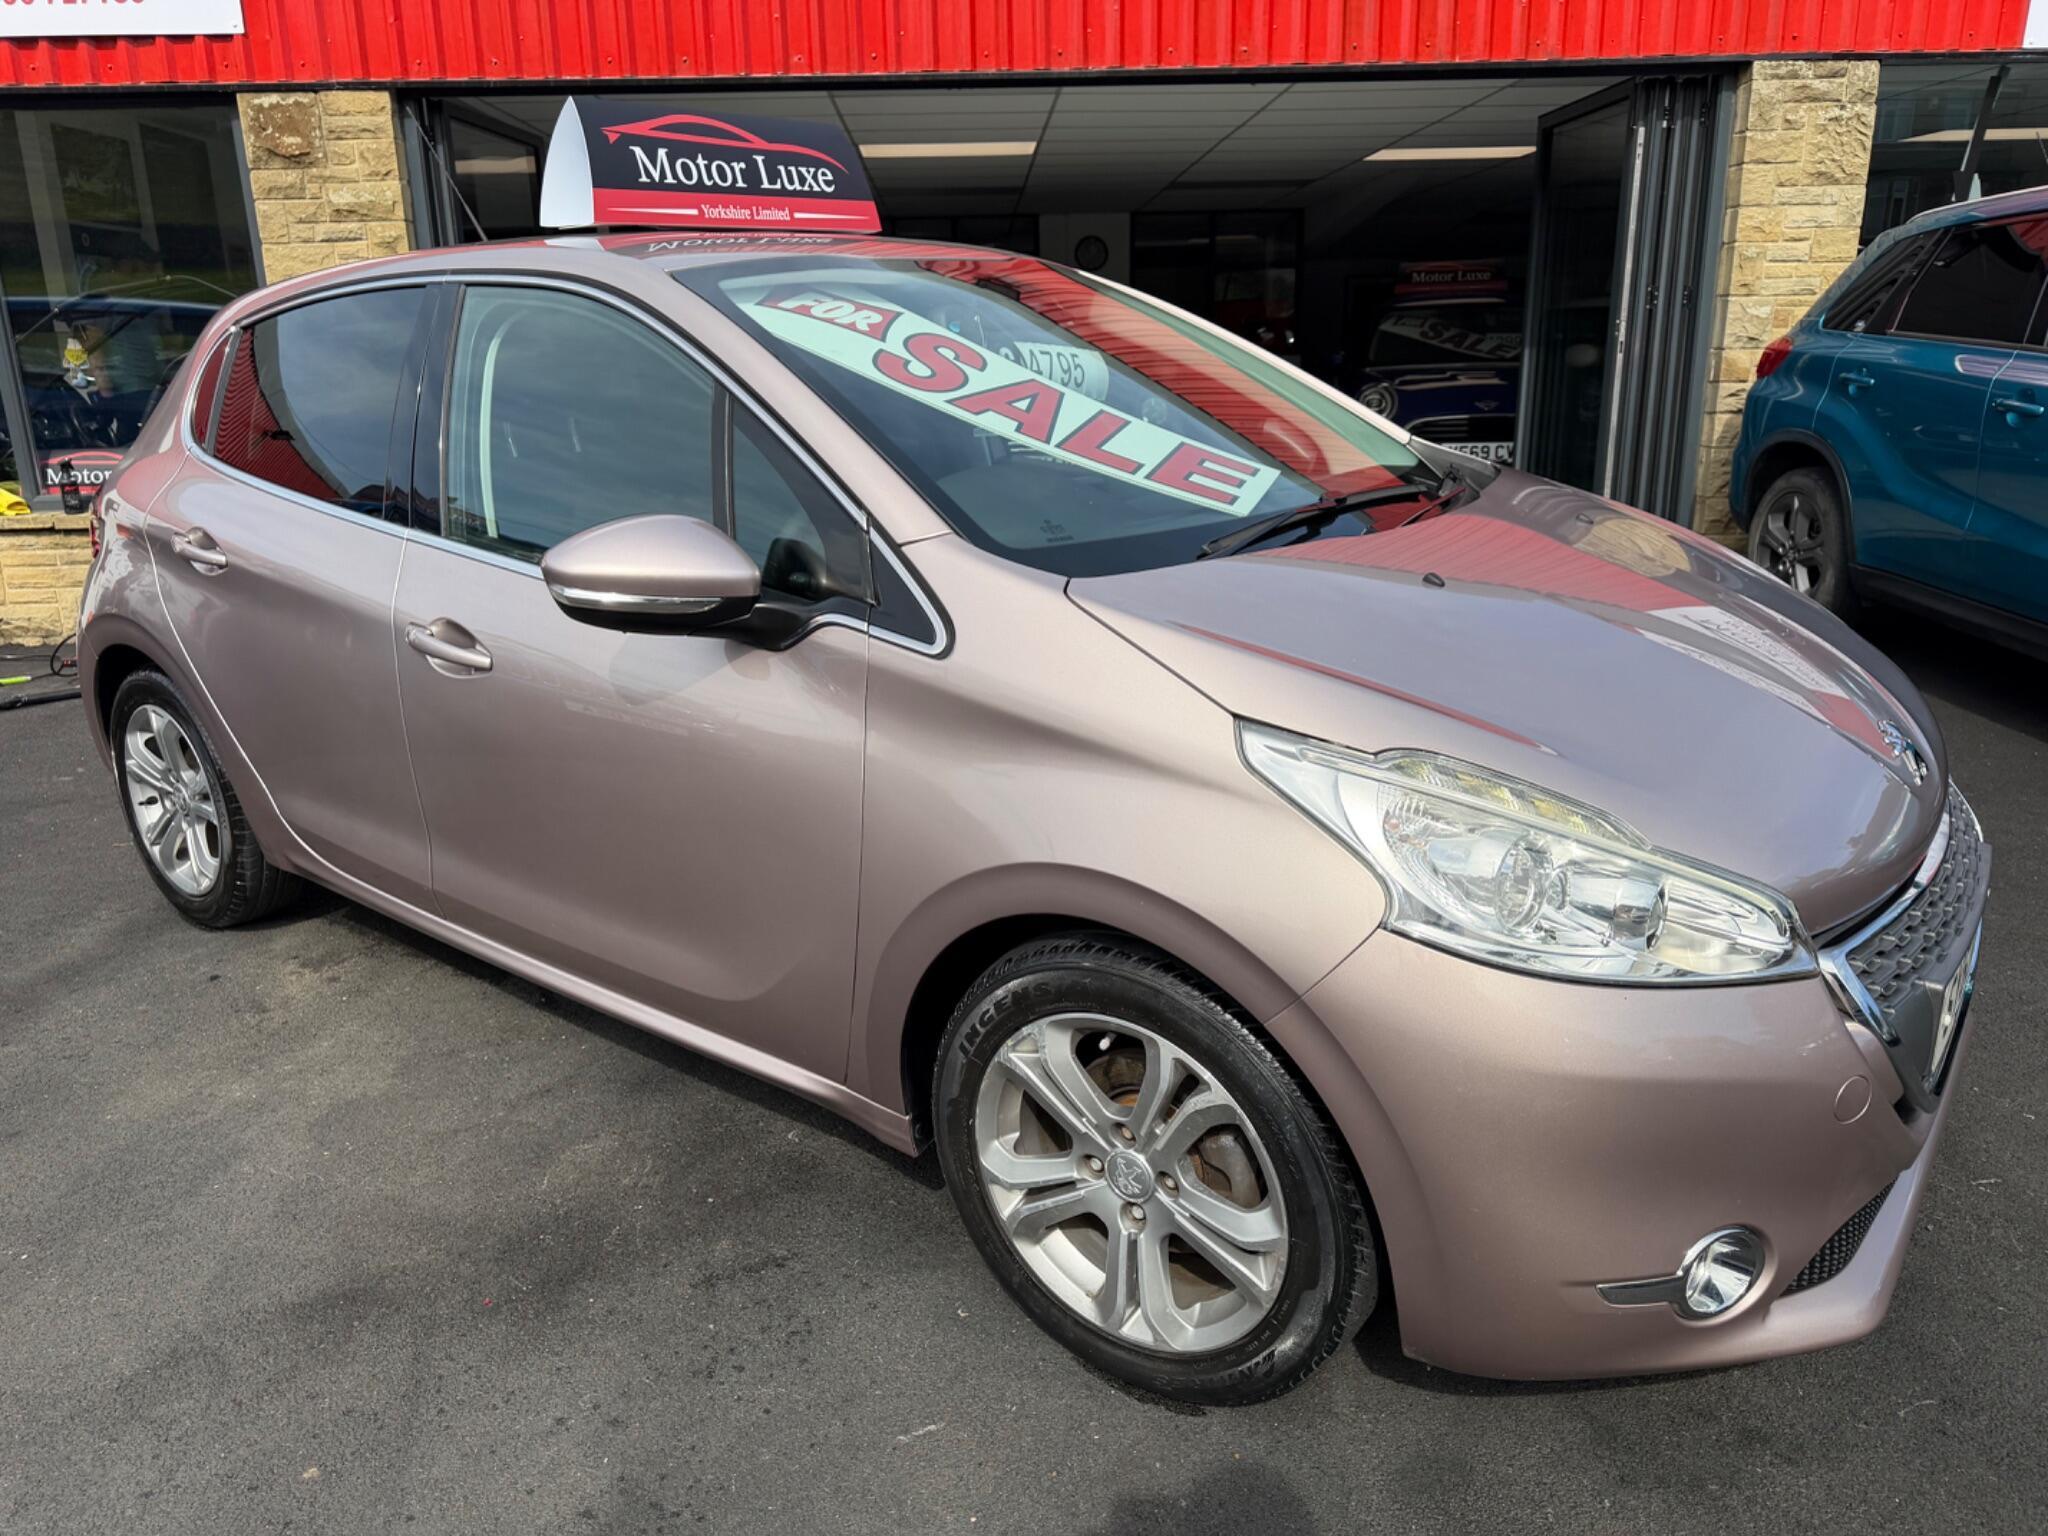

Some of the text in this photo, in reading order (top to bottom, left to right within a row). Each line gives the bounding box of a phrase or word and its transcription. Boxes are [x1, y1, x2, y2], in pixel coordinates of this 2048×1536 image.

[629, 145, 835, 193] Motor Luxe
[700, 204, 791, 221] Yorkshire Limited
[1411, 270, 1492, 284] Motor Luxe
[1419, 319, 1521, 359] SALE
[778, 293, 1261, 506] FOR SALE
